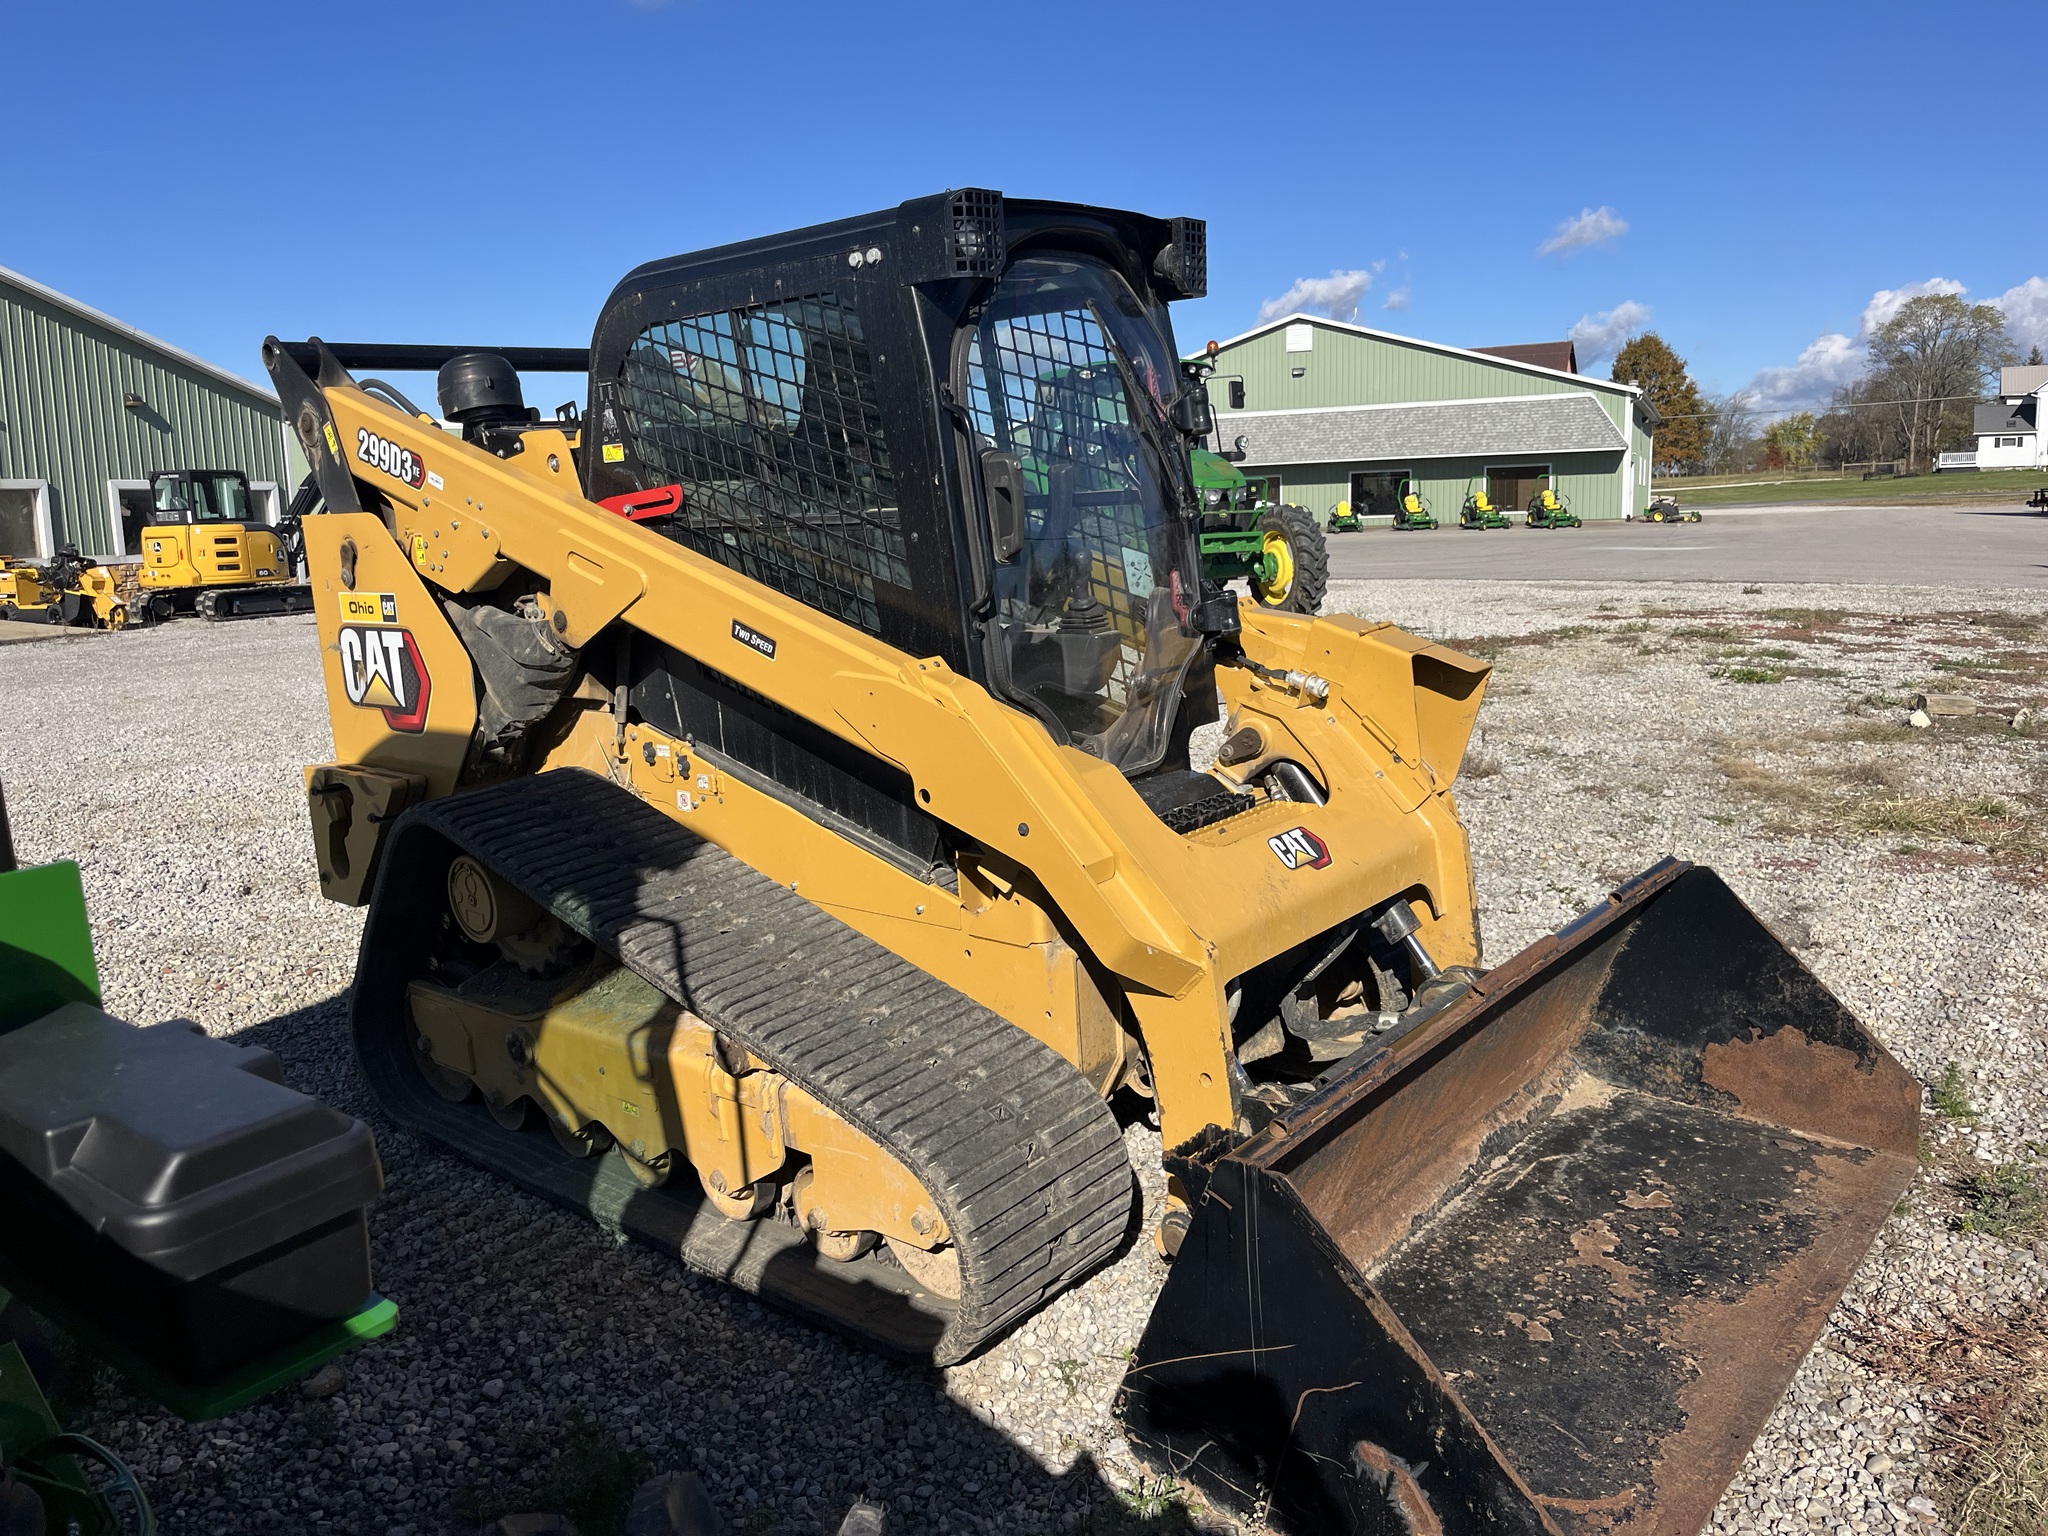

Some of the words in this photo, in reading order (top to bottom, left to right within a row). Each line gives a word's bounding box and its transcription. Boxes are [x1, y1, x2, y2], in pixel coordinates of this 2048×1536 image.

[358, 428, 413, 483] 299D3
[412, 465, 421, 478] XE
[258, 569, 269, 577] 60
[348, 601, 375, 615] Ohio
[381, 601, 395, 616] CAT
[340, 627, 406, 708] CAT
[1268, 828, 1319, 869] CAT
